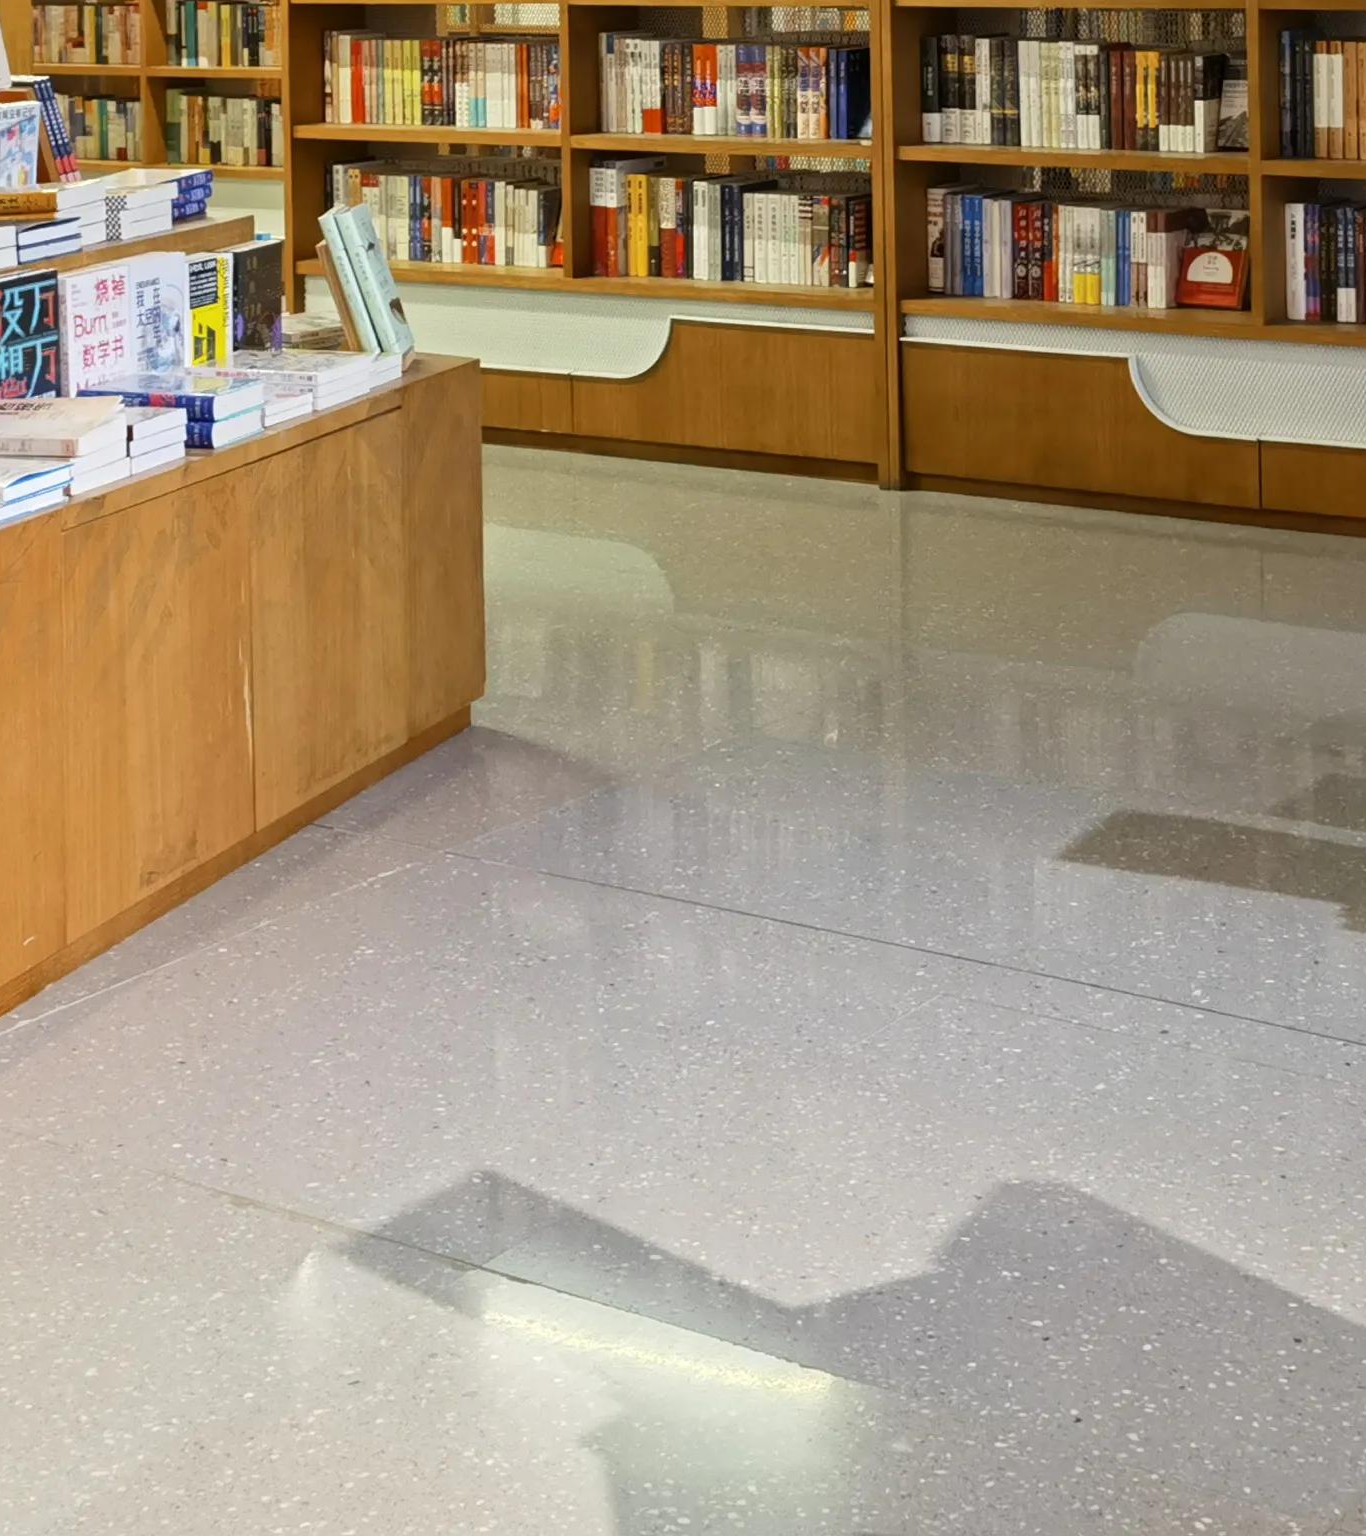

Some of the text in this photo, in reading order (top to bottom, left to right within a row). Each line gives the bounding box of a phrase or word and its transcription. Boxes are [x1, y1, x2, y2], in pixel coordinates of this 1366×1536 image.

[73, 314, 108, 339] Burn
[82, 336, 125, 370] 数学书
